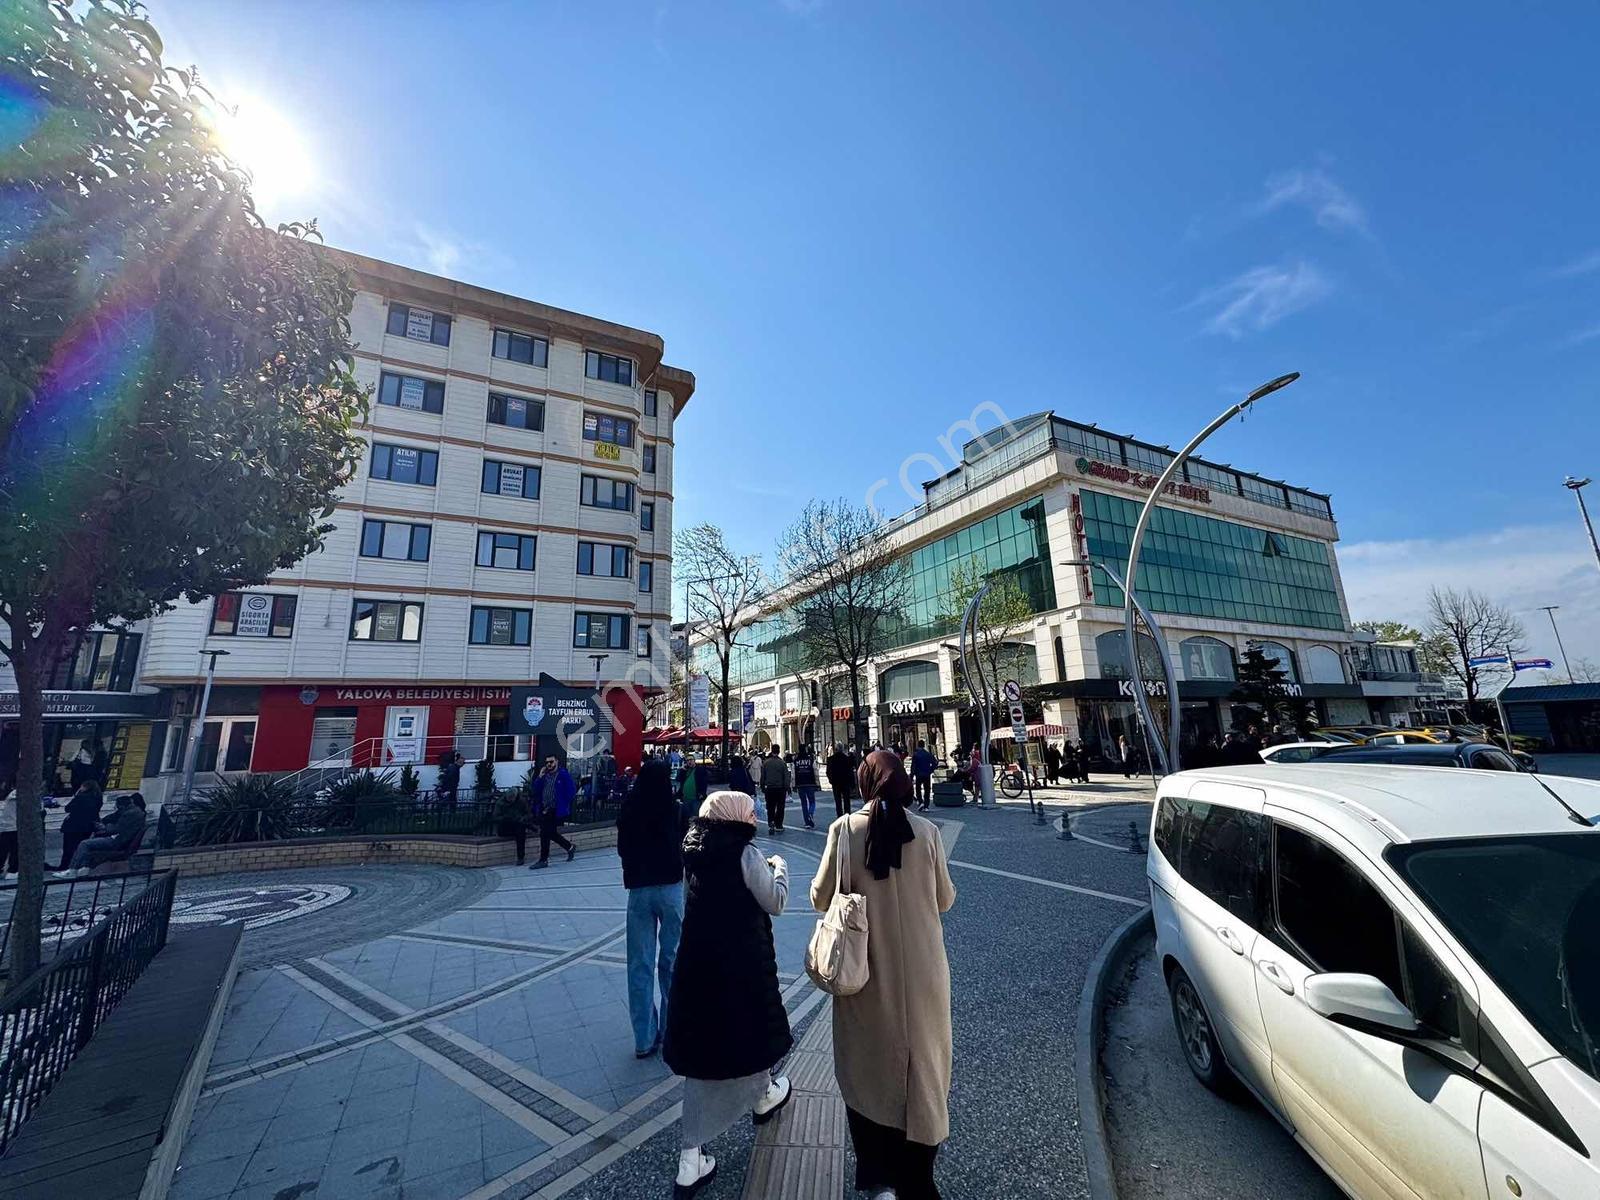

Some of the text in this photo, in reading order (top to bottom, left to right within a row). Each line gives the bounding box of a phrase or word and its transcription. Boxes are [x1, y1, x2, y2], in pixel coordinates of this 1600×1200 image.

[336, 689, 392, 700] YALOVA
[396, 688, 474, 700] BELEDİYESİ
[557, 698, 587, 707] BENZİNCİ
[548, 708, 594, 716] TAYFUN ERBUL
[833, 709, 850, 720] FLO
